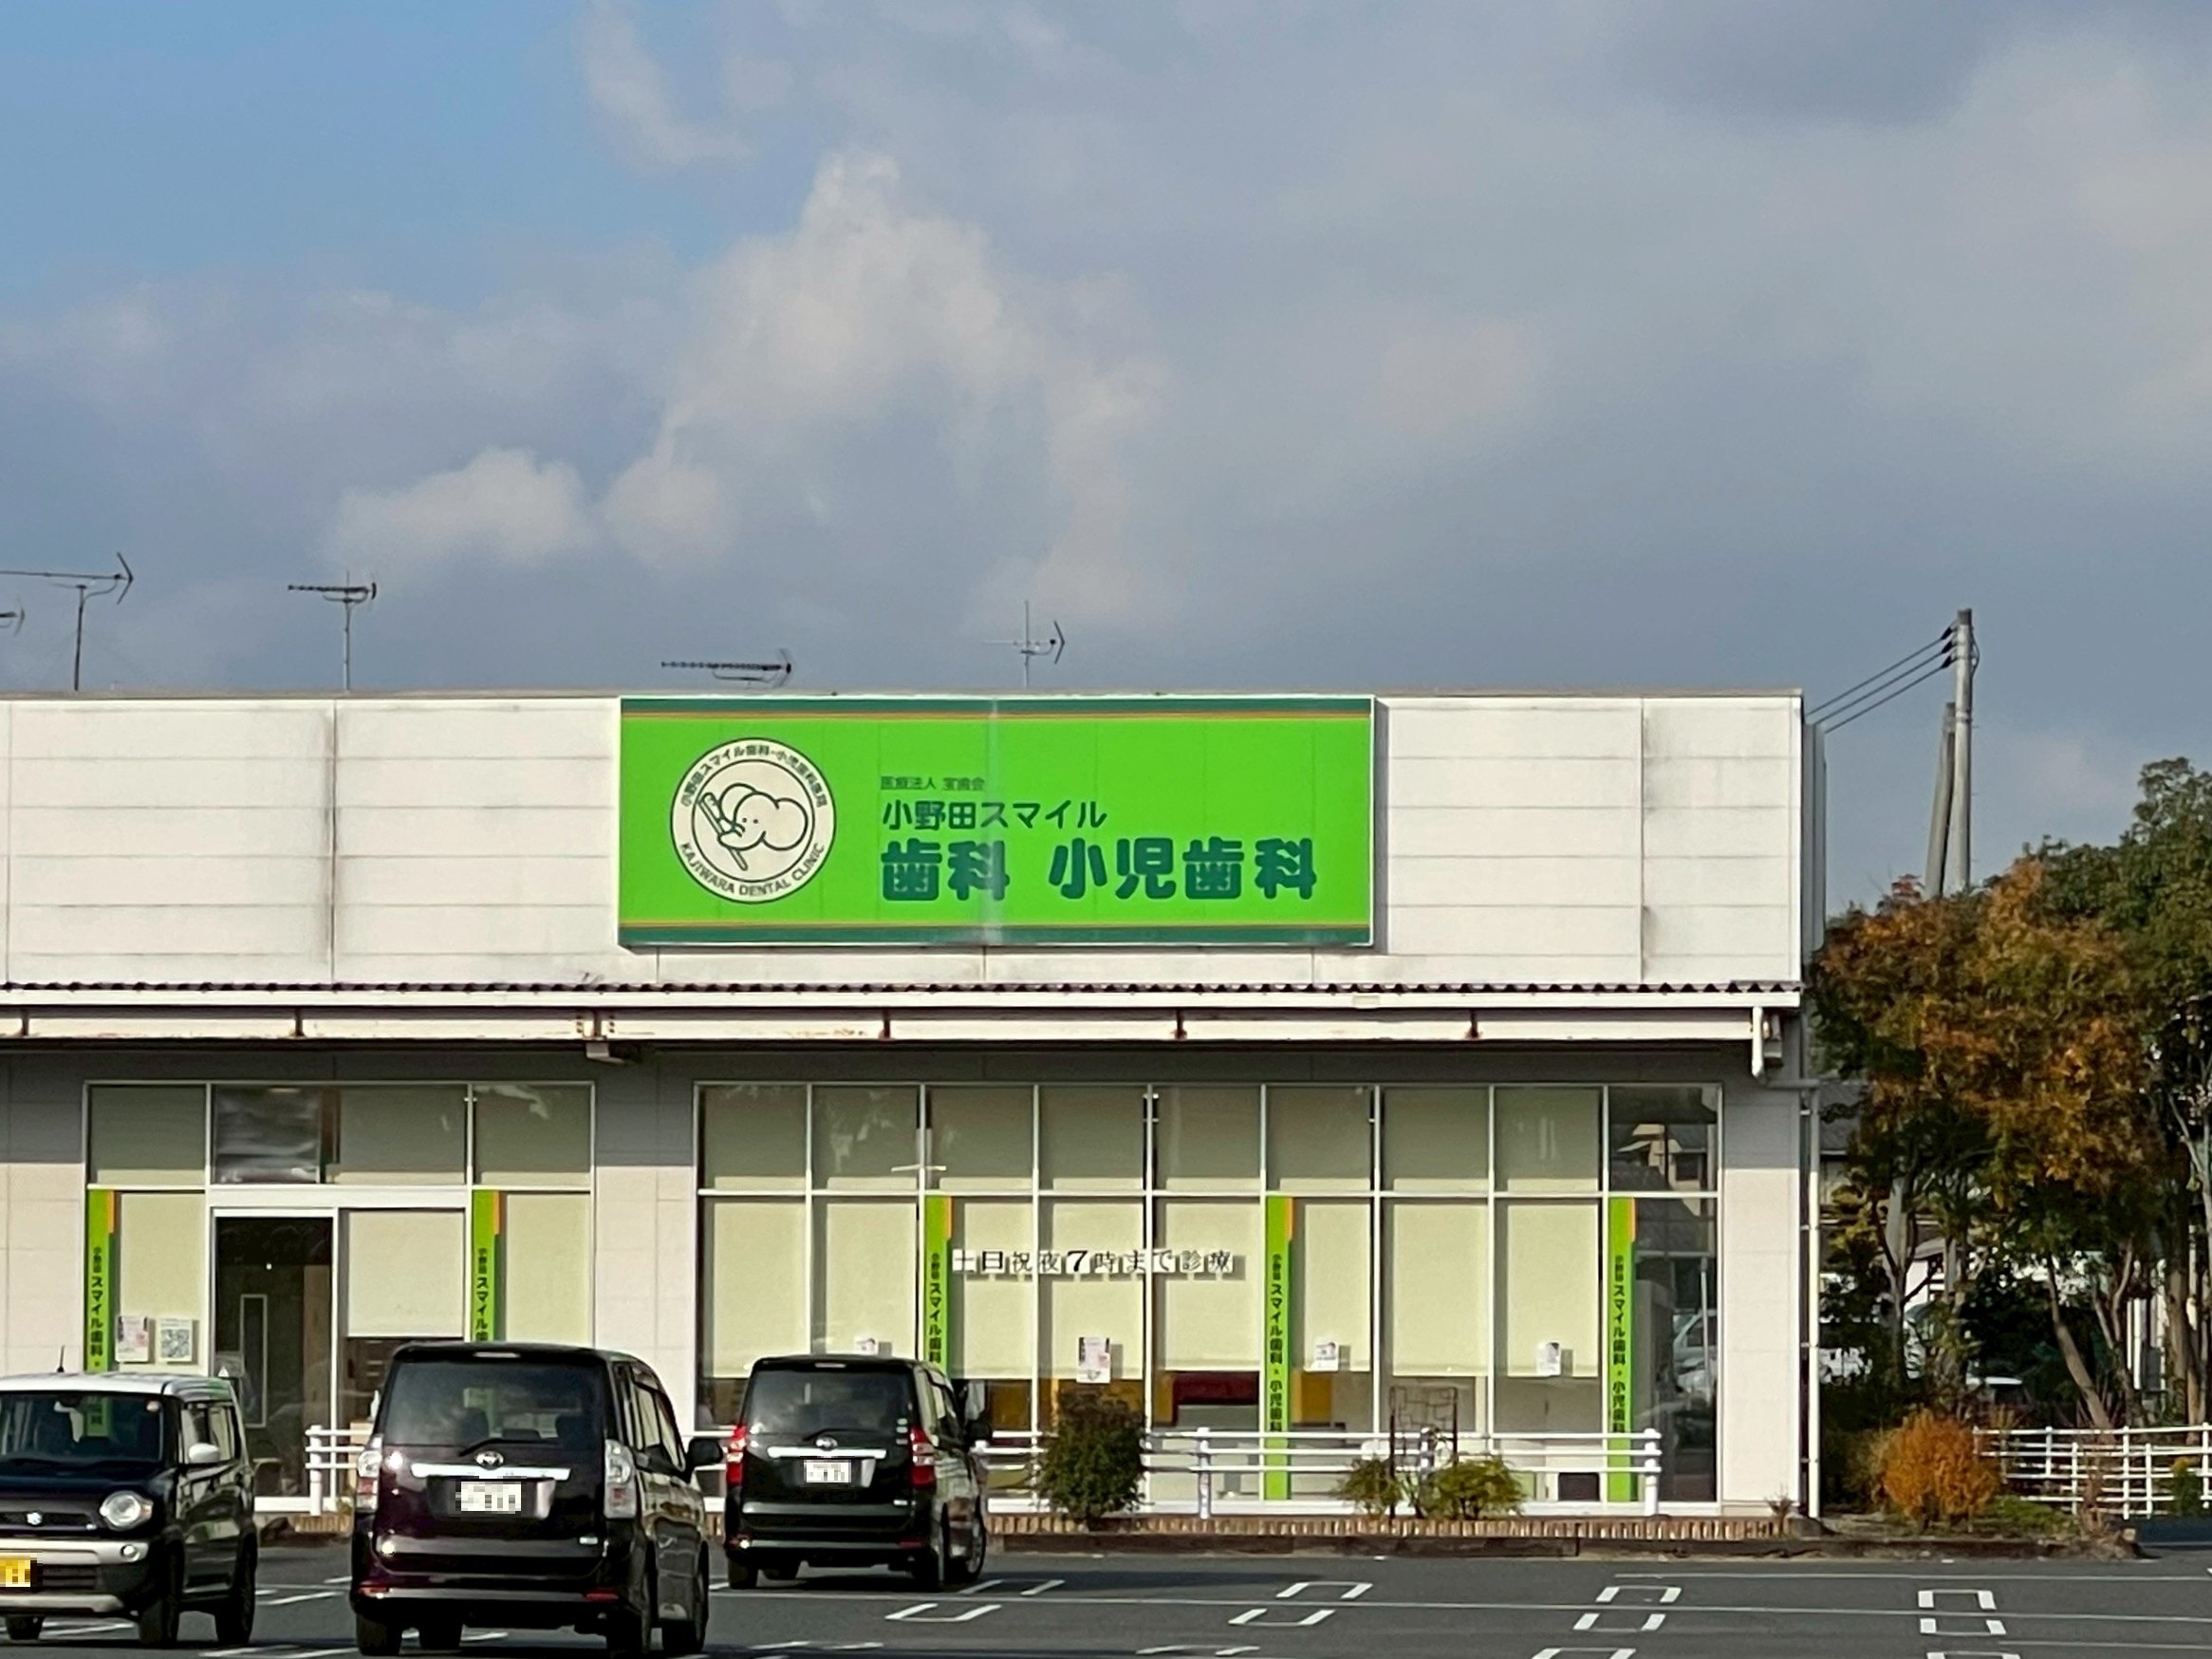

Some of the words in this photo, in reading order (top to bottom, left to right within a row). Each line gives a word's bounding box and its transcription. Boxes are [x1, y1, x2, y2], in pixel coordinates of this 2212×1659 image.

[883, 799, 1107, 830] 小野田スマイル
[680, 842, 735, 894] KAJIWARA
[738, 879, 791, 897] DENTAL
[791, 842, 825, 882] CLINIC
[881, 837, 1010, 901] 歯科
[1049, 836, 1317, 900] 小児歯科
